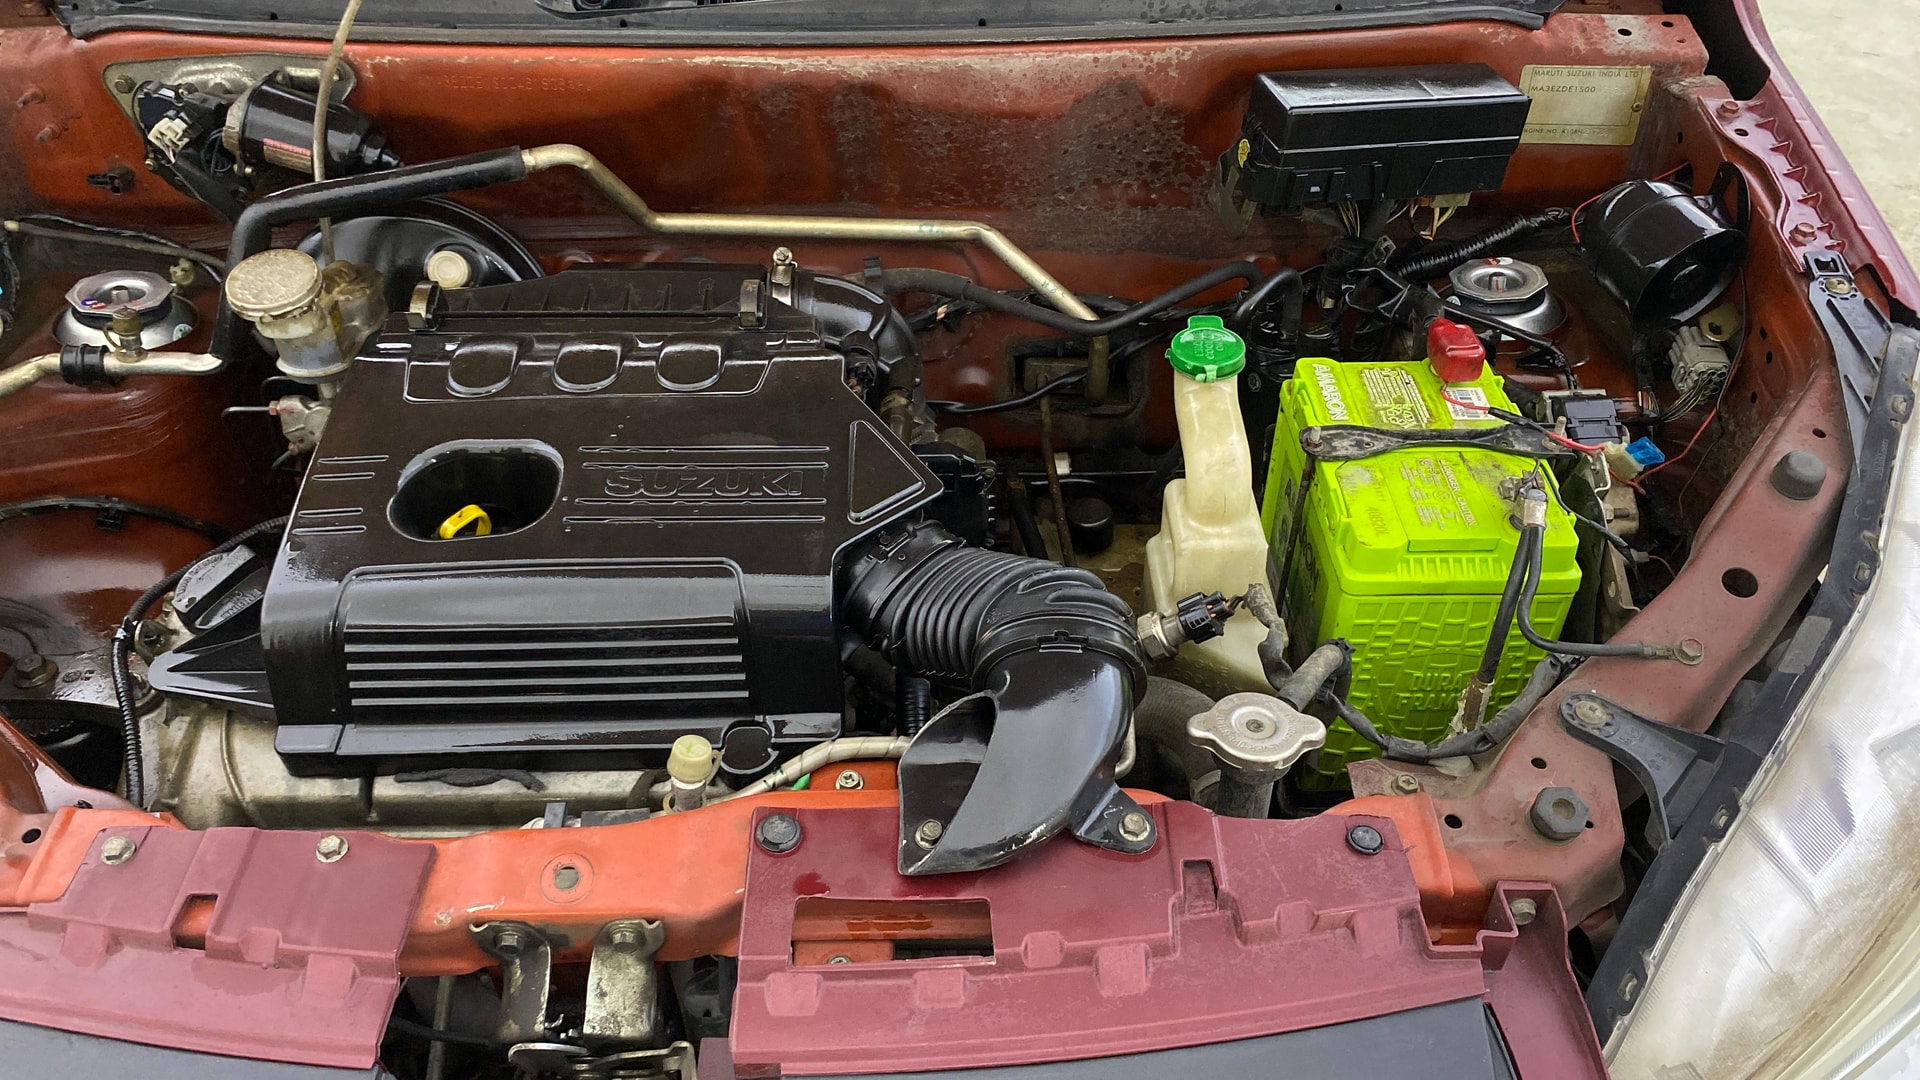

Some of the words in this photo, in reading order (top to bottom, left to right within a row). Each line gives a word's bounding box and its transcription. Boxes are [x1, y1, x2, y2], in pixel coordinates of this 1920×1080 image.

[1533, 69, 1563, 77] MARUTI
[1624, 70, 1640, 78] LTD
[1311, 363, 1350, 421] AMARON
[604, 470, 803, 497] SUZUKI
[1410, 672, 1463, 690] DURA
[1396, 692, 1460, 710] FRAM
